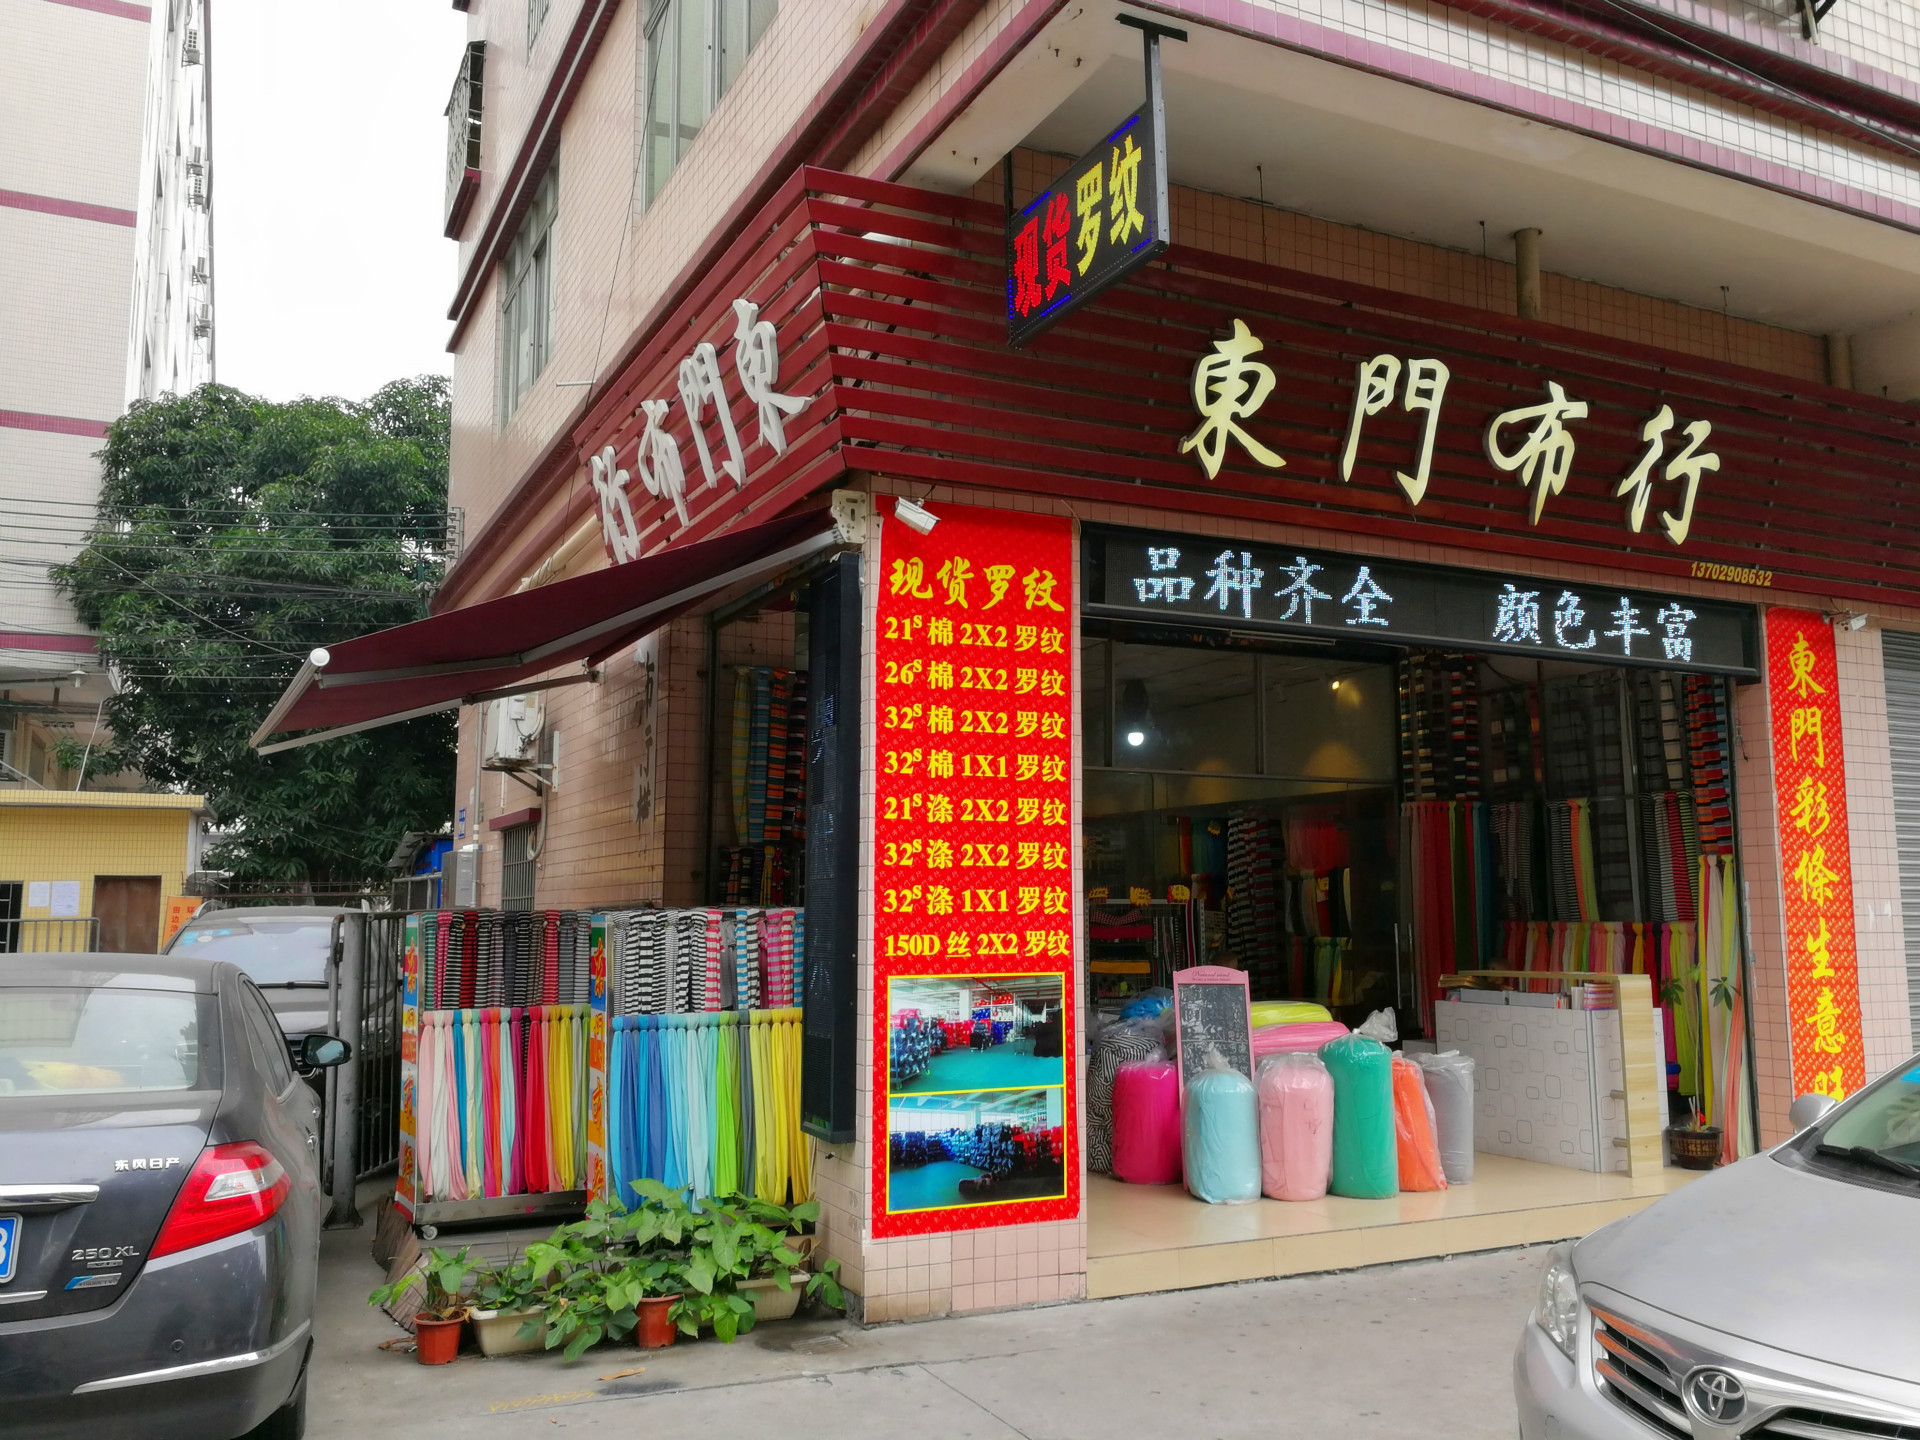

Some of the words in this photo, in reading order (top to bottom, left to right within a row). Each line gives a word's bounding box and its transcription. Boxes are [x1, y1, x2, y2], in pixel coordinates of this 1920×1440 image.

[1013, 134, 1144, 317] 现货罗纹
[1179, 318, 1720, 545] 東門布行
[890, 556, 1065, 612] 现货罗纹
[1691, 561, 1772, 586] 13702908632
[1133, 547, 1393, 626] 品种齐全
[1492, 584, 1697, 662] 颜色丰富
[1015, 625, 1064, 653] 罗纹
[1015, 668, 1065, 696] 罗纹
[1015, 711, 1065, 739] 罗纹
[1016, 754, 1066, 782] 罗纹
[1016, 798, 1066, 825] 罗纹
[1017, 842, 1067, 870] 罗纹
[1017, 886, 1068, 914] 罗纹
[885, 935, 940, 956] 150D
[1025, 930, 1070, 956] 罗纹
[115, 1157, 180, 1172] 东风日产
[72, 1248, 112, 1260] 250
[114, 1246, 140, 1257] XL
